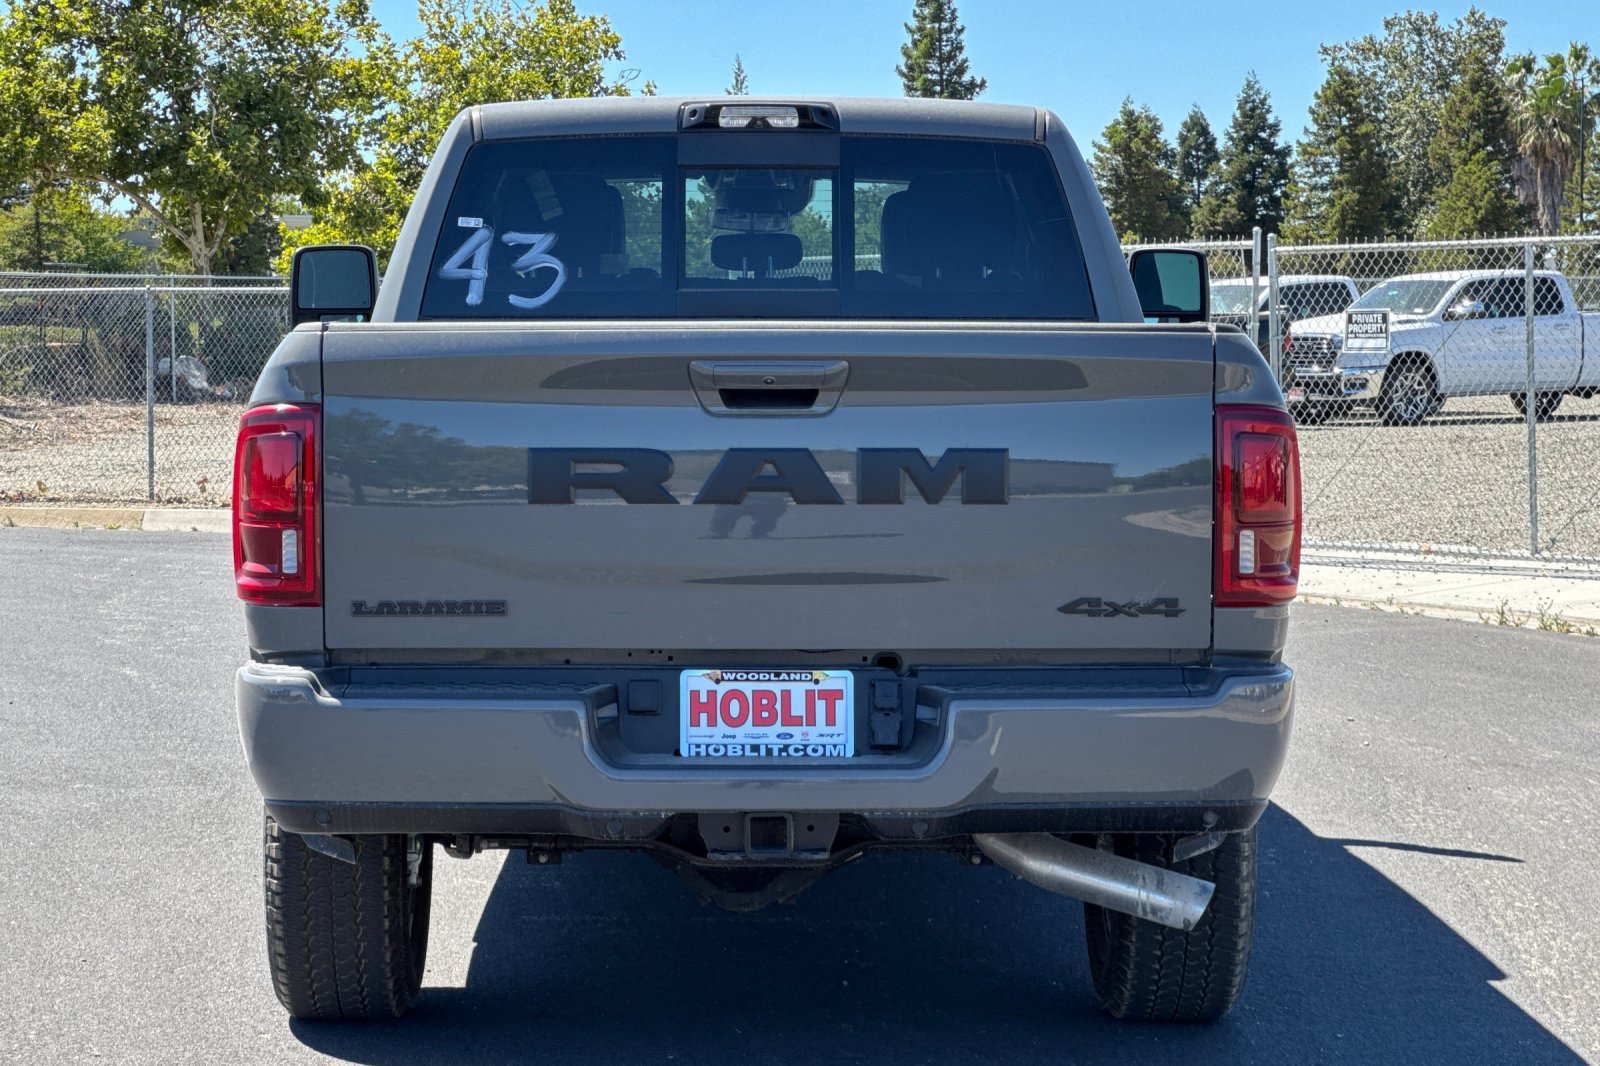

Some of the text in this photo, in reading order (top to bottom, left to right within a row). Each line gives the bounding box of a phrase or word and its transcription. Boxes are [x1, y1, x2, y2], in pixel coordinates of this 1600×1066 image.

[438, 227, 567, 309] 43
[1352, 313, 1382, 323] PRIVATE
[1348, 323, 1386, 333] PROPERTY
[527, 447, 1009, 505] RAM
[351, 600, 508, 617] LARAMIE
[1057, 597, 1187, 618] 4x4
[721, 671, 812, 681] WOODLAND
[689, 688, 844, 728] HOBLIT
[690, 744, 846, 757] HOBLIT.COM
